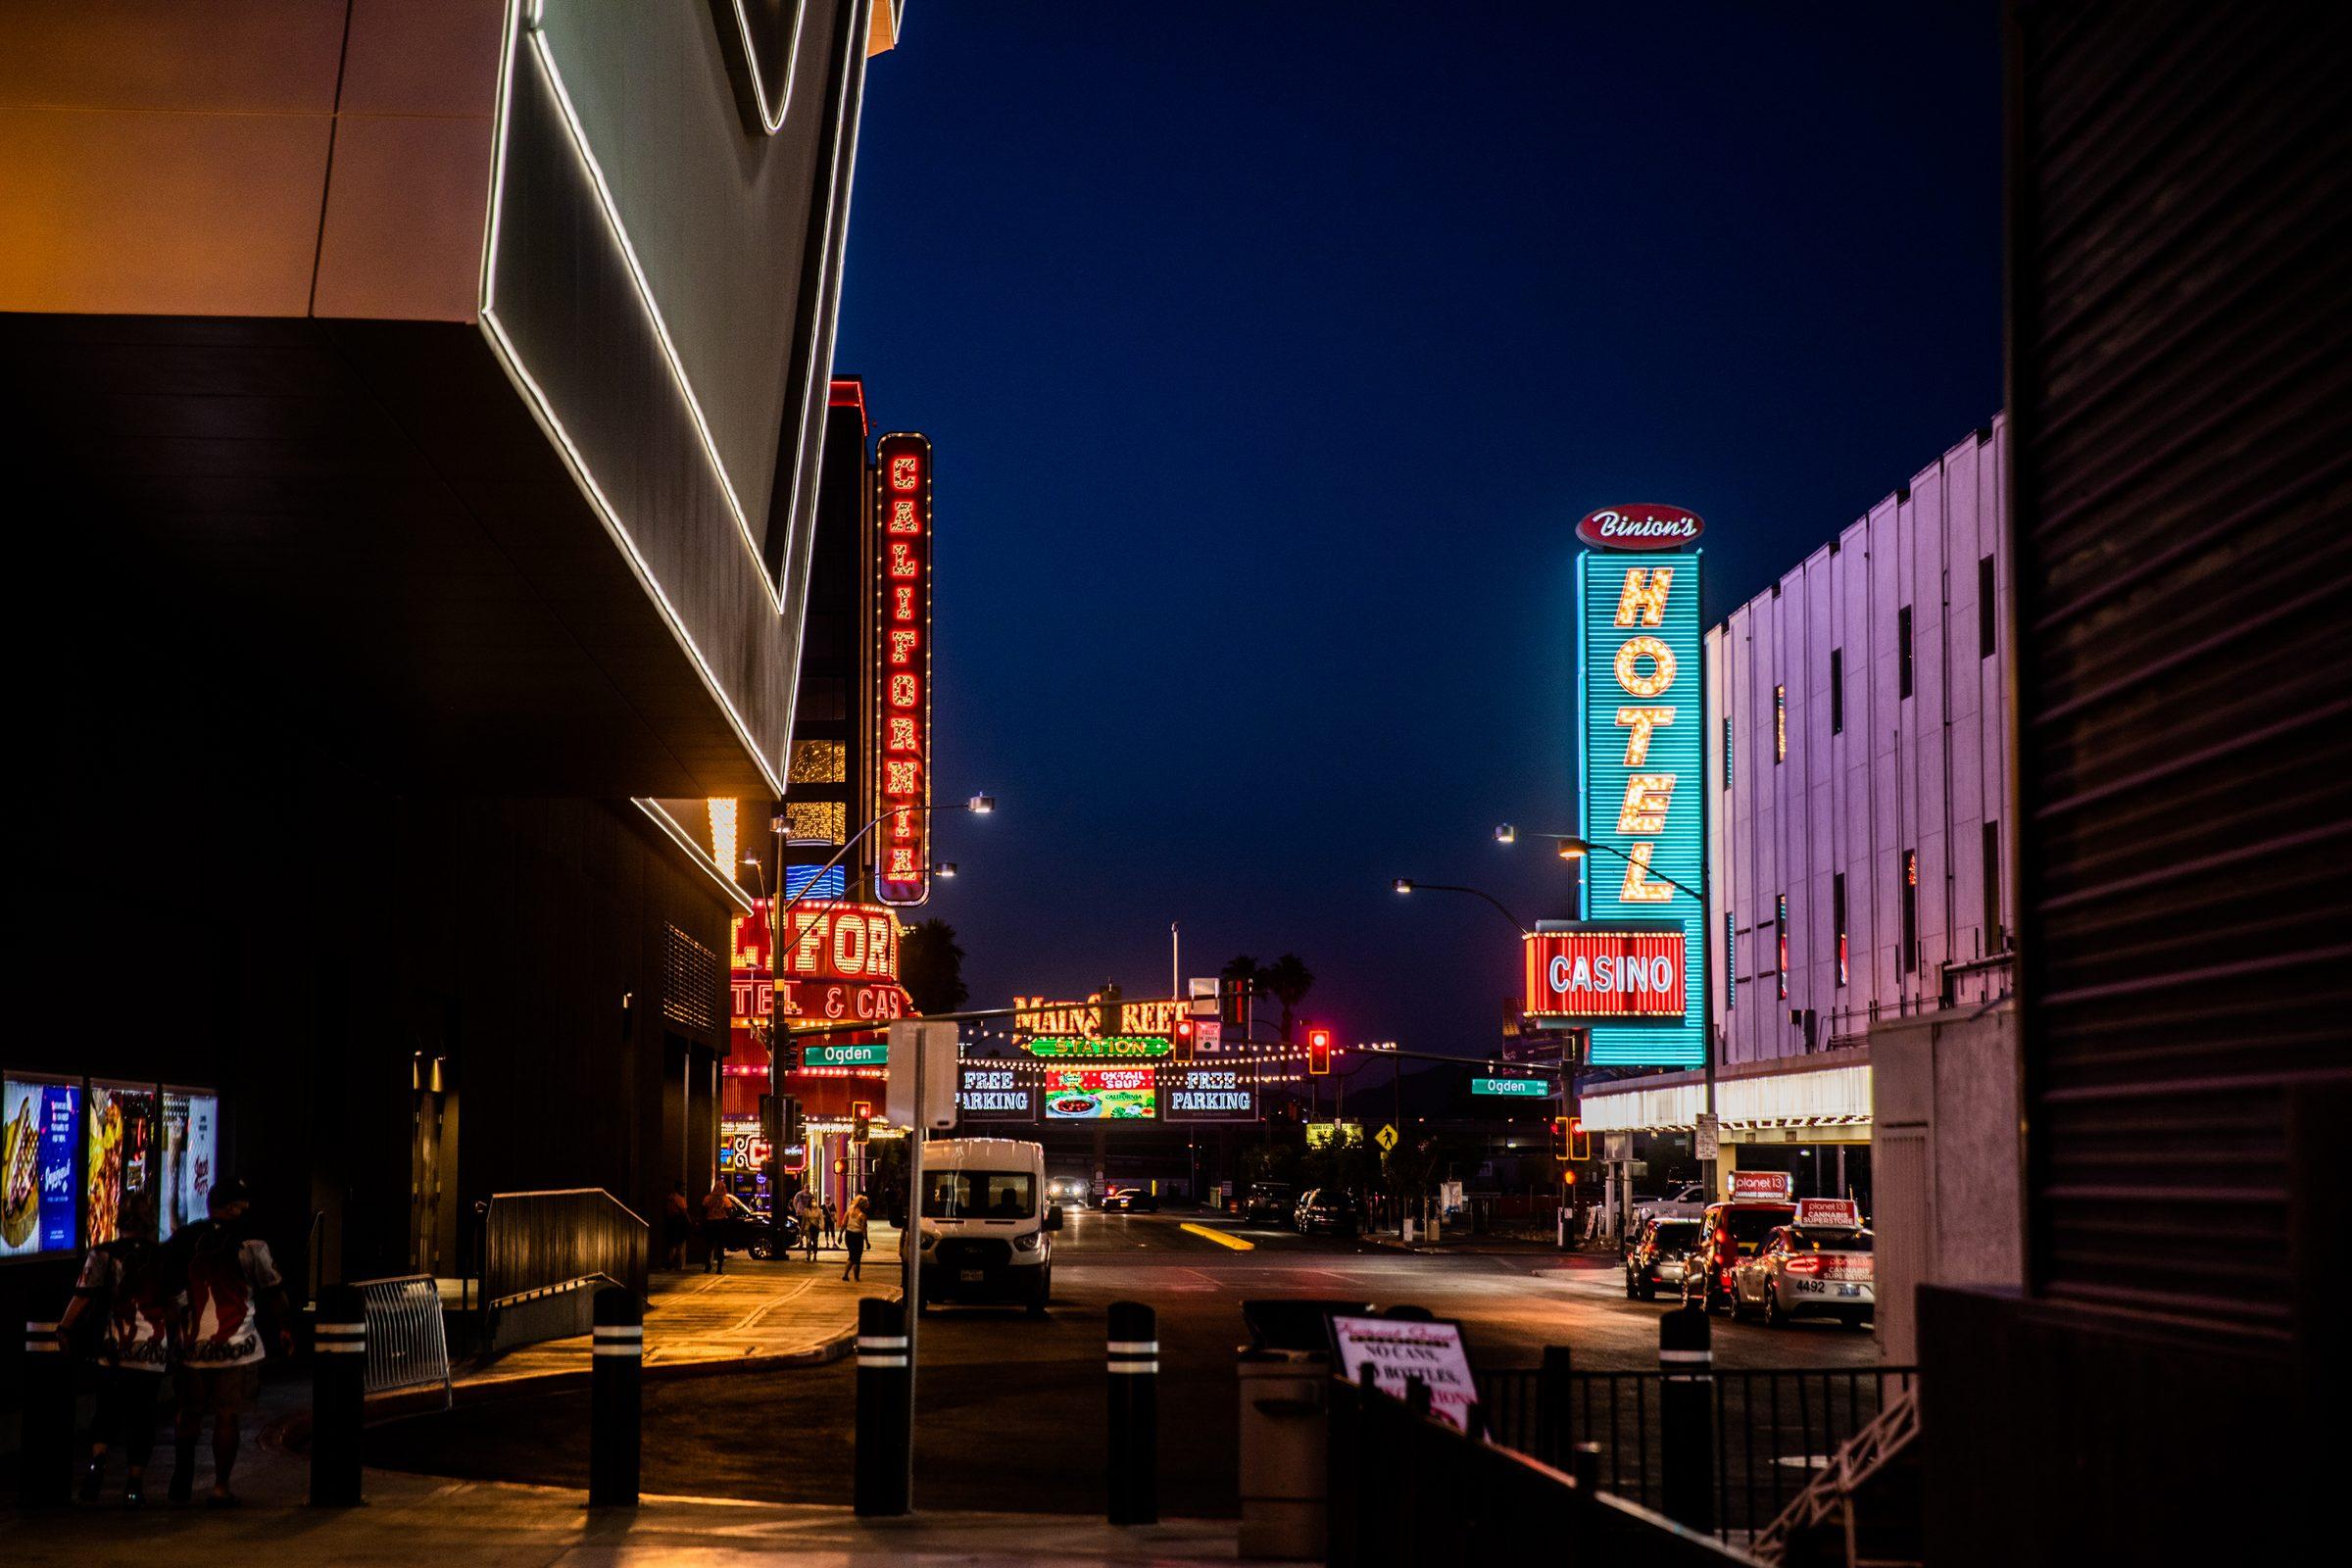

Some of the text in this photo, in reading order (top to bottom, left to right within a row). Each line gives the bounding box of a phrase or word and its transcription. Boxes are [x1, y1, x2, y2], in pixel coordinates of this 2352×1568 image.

[1592, 511, 1697, 537] Binion's
[888, 458, 917, 881] CALIFORNIA
[1614, 567, 1676, 903] HOTEL
[1549, 956, 1673, 993] CASINO
[825, 988, 844, 1018] &
[1084, 994, 1190, 1040] SREET
[824, 1046, 871, 1064] Ogden
[1054, 1040, 1146, 1054] STATION
[964, 1072, 1013, 1089] FREE
[1105, 1080, 1142, 1089] SOUP
[1187, 1072, 1236, 1089] FREE
[1488, 1079, 1525, 1095] Ogden
[1172, 1092, 1250, 1110] PARKING
[1736, 1177, 1770, 1191] planet
[1808, 1202, 1835, 1211] planet
[1796, 1280, 1824, 1294] 4492
[1365, 1345, 1389, 1359] NO
